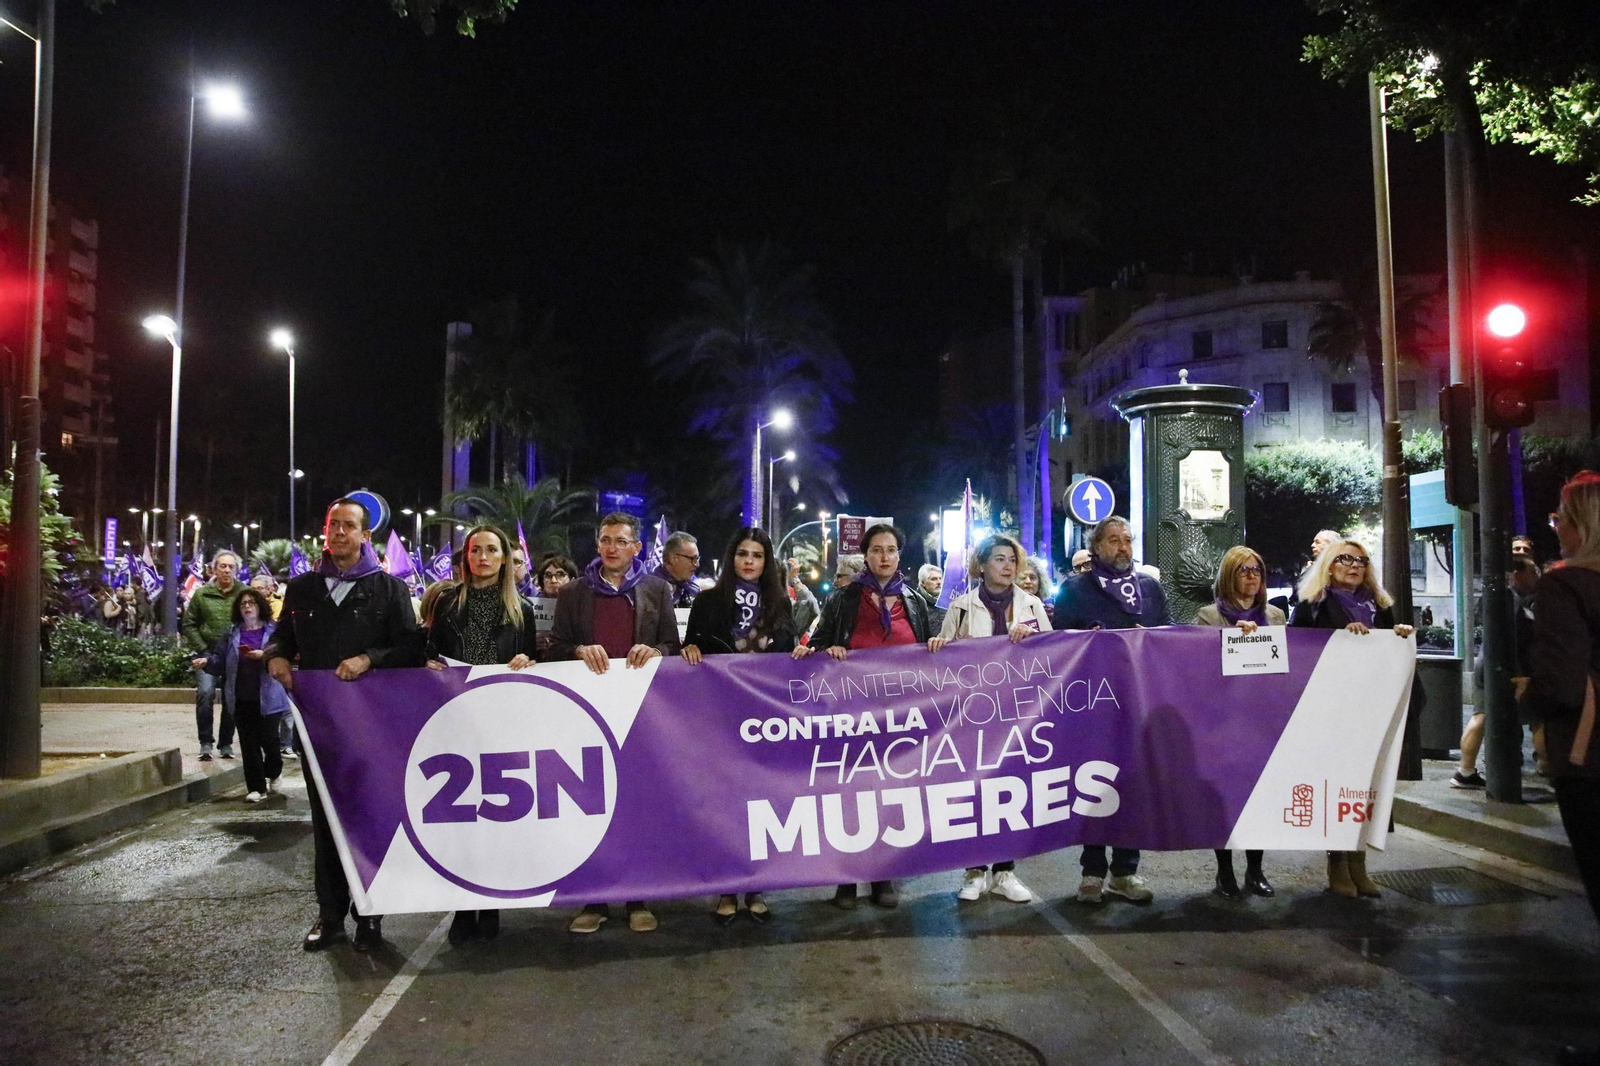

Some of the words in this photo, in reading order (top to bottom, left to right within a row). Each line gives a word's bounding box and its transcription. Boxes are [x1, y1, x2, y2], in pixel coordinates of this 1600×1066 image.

[1227, 634, 1272, 644] Purificación
[739, 711, 882, 743] CONTRA
[885, 707, 928, 733] LA
[930, 677, 1121, 728] VIOLENCIA
[788, 672, 838, 704] DÍA
[841, 655, 1063, 701] INTERNACIONAL
[418, 745, 606, 824] 25N
[808, 733, 966, 787] HACIA
[976, 721, 1055, 771] LAS
[747, 760, 1121, 861] MUJERES
